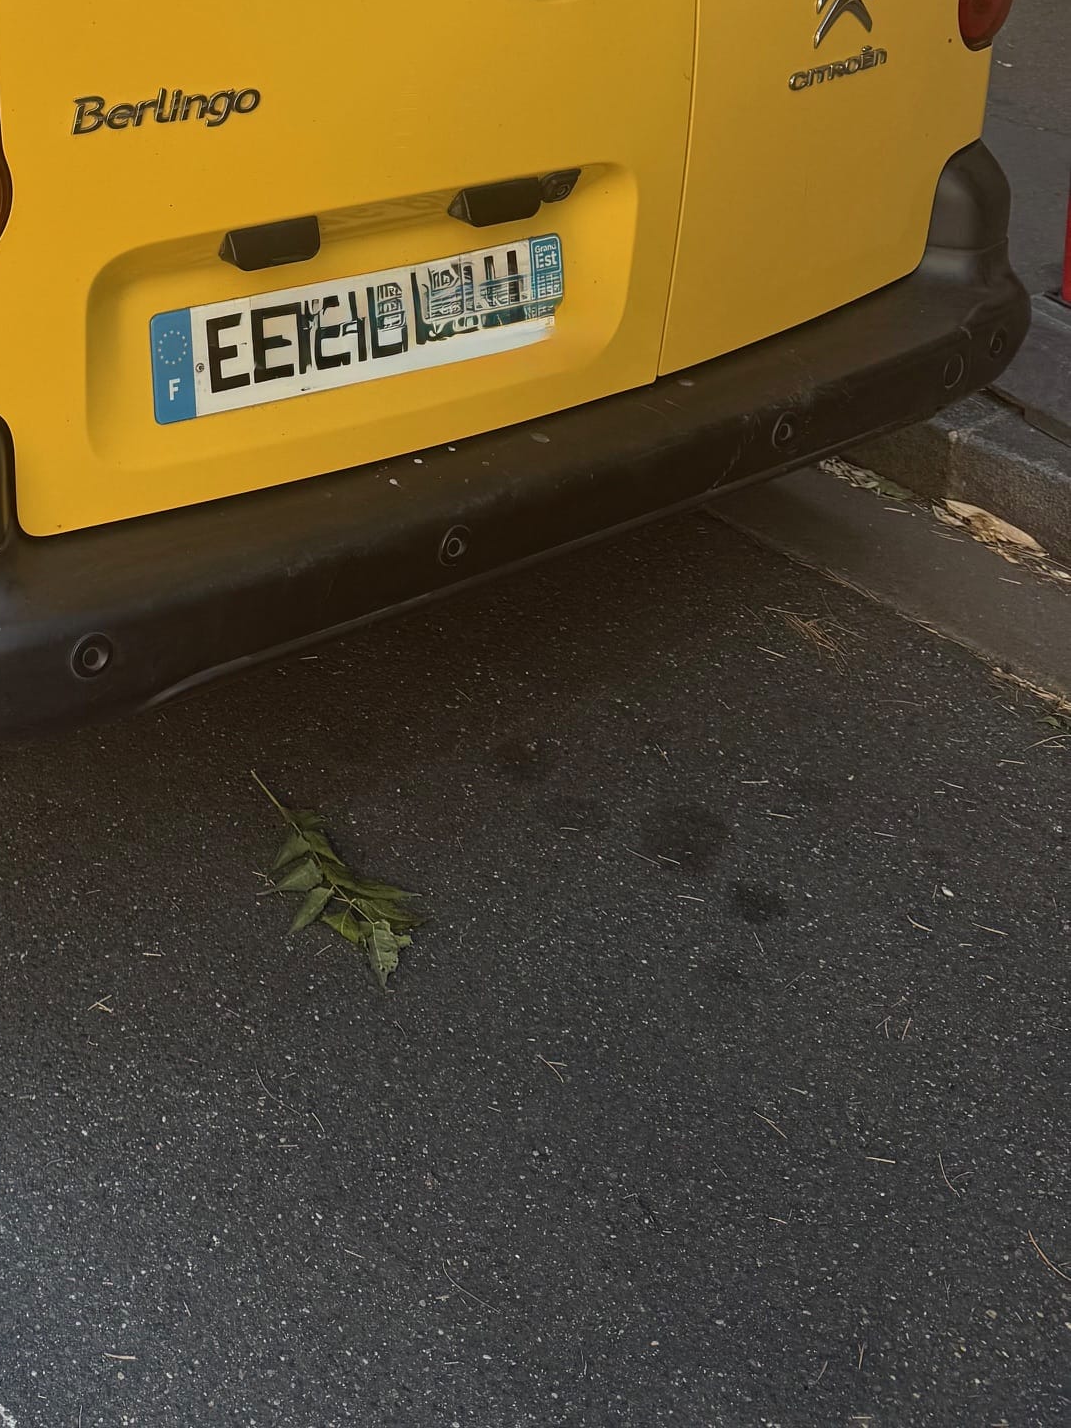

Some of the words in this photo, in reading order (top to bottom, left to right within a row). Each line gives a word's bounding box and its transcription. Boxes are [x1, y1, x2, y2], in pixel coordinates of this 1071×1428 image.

[71, 87, 261, 135] Berlingo
[534, 240, 557, 253] Grand
[535, 251, 558, 269] Est
[168, 377, 183, 401] F
